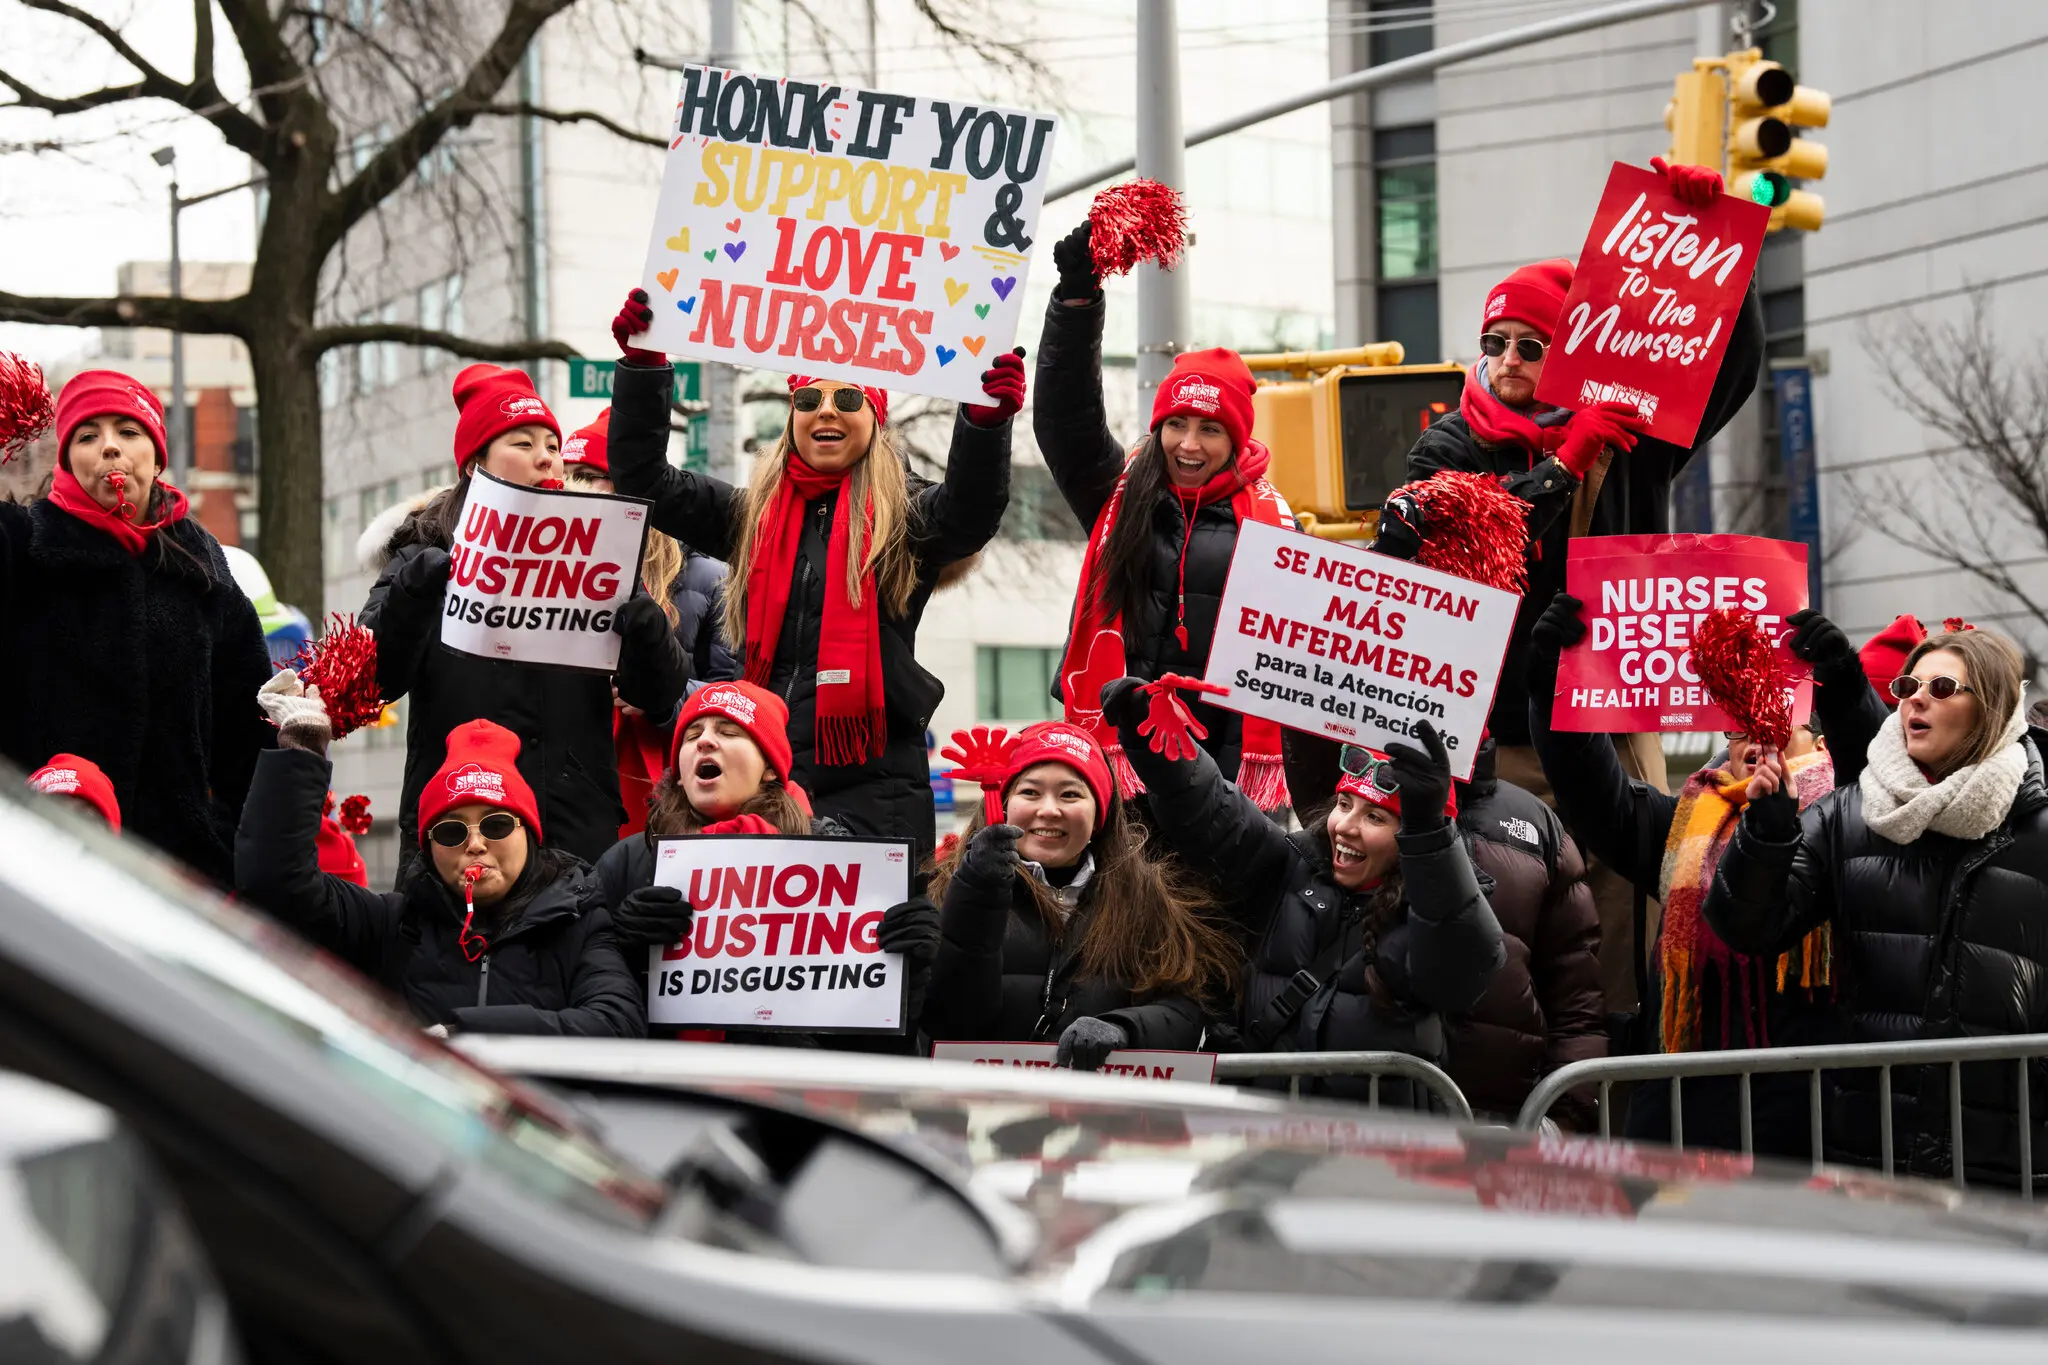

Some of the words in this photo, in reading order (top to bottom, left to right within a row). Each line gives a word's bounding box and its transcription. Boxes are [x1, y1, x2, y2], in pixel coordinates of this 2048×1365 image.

[680, 69, 841, 152] HONK
[847, 91, 915, 159] IF
[931, 101, 1054, 183] YOU
[694, 142, 967, 239] SUPPORT
[985, 183, 1033, 252] &
[766, 217, 924, 301] LOVE
[1618, 266, 1650, 298] To
[1648, 287, 1697, 327] The
[689, 279, 933, 376] NURSES
[1565, 302, 1722, 366] Nurses!
[1610, 381, 1628, 392] New
[1628, 385, 1643, 398] York
[1643, 391, 1659, 402] State
[464, 503, 601, 556] UNION
[448, 544, 621, 601] BUSTING
[1273, 546, 1310, 575] SE
[1313, 557, 1479, 622] NECESITAN
[1602, 576, 1768, 614] NURSES
[446, 594, 612, 632] DISGUSTING
[1323, 595, 1407, 640] MÁS
[1592, 613, 1780, 652] DESEE
[1238, 607, 1478, 698] ENFERMERAS
[1255, 652, 1307, 679] para
[1314, 664, 1333, 687] la
[1338, 673, 1445, 718] Atención
[1571, 687, 1660, 708] HEALTH
[1234, 669, 1314, 708] Segura
[1320, 694, 1355, 720] del
[1362, 705, 1459, 751] Paciete
[1324, 721, 1357, 737] NURSES
[456, 774, 503, 786] NURSES
[1499, 820, 1526, 833] NORTH
[1508, 828, 1526, 840] FACE
[1511, 817, 1526, 826] THE
[688, 863, 861, 911] UNION
[662, 911, 886, 961] BUSTING
[658, 970, 684, 997] IS
[691, 962, 886, 995] DISGUSTING
